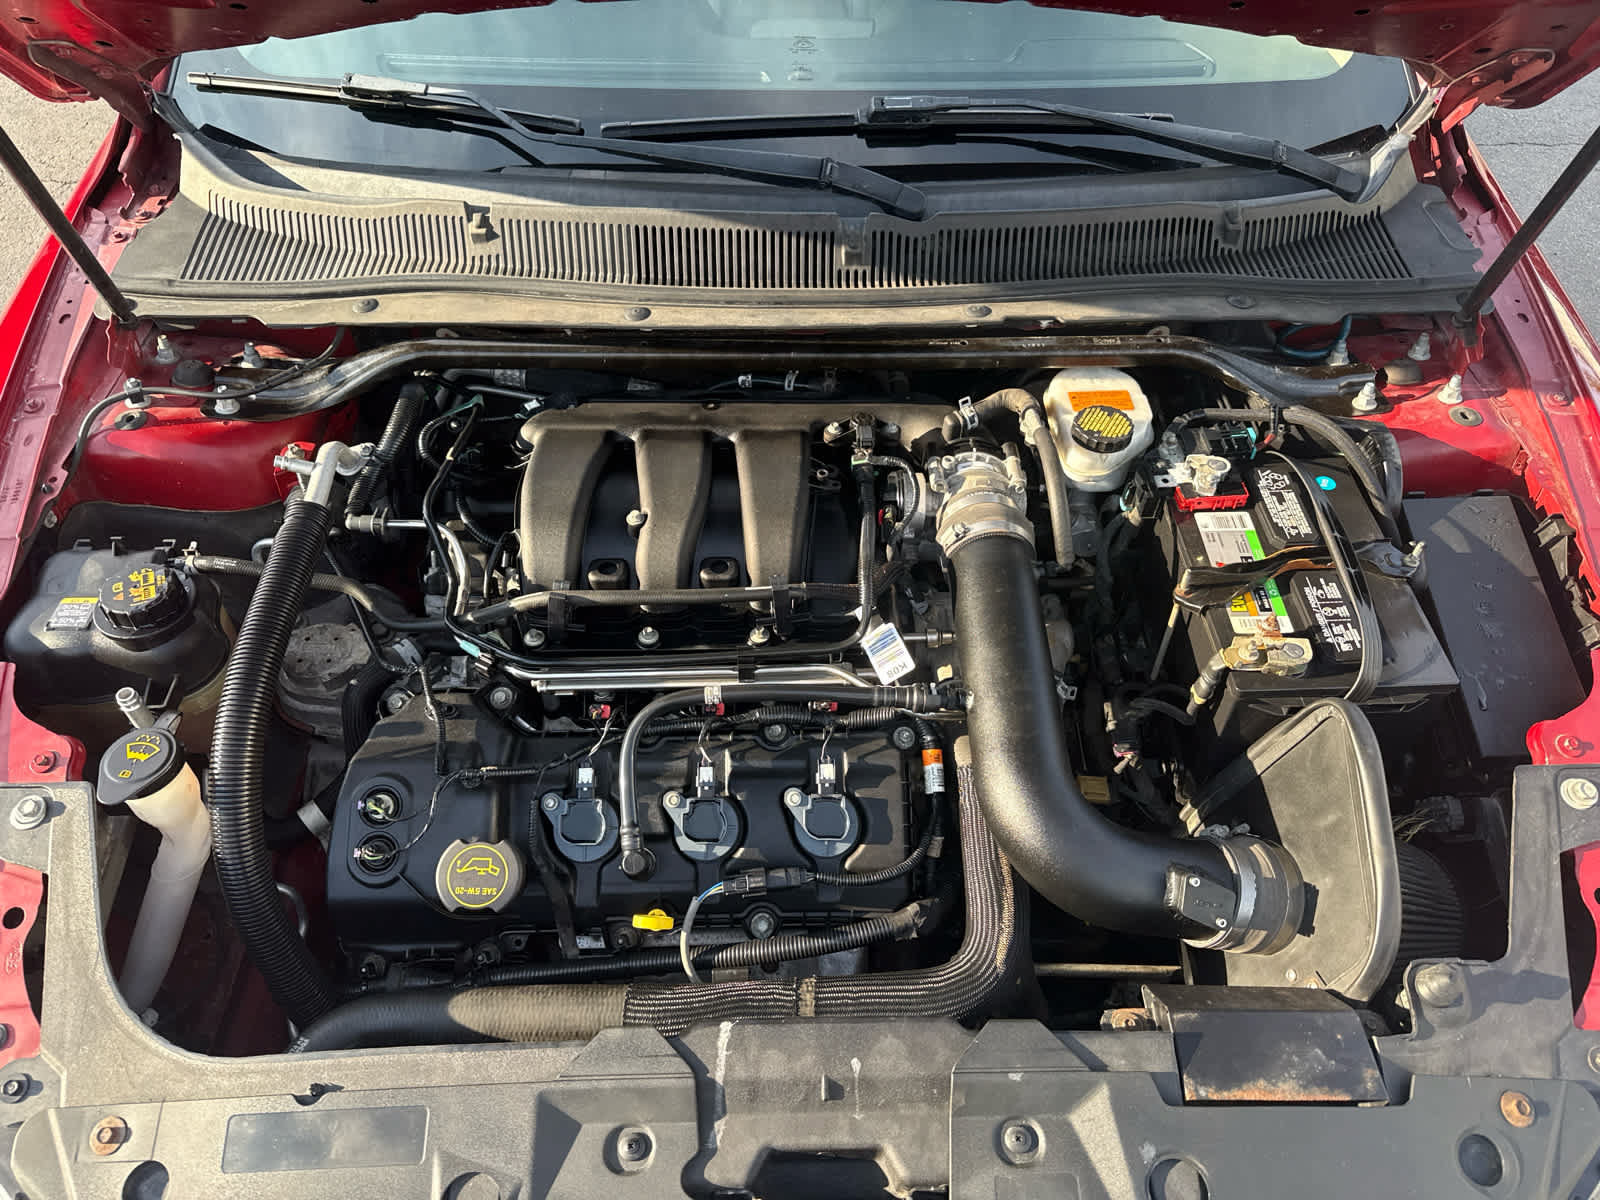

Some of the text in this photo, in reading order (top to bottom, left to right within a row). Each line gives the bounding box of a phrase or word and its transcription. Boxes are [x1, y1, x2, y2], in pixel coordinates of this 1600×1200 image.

[1315, 612, 1331, 637] DANGER
[455, 886, 497, 895] SAE 5W-20
